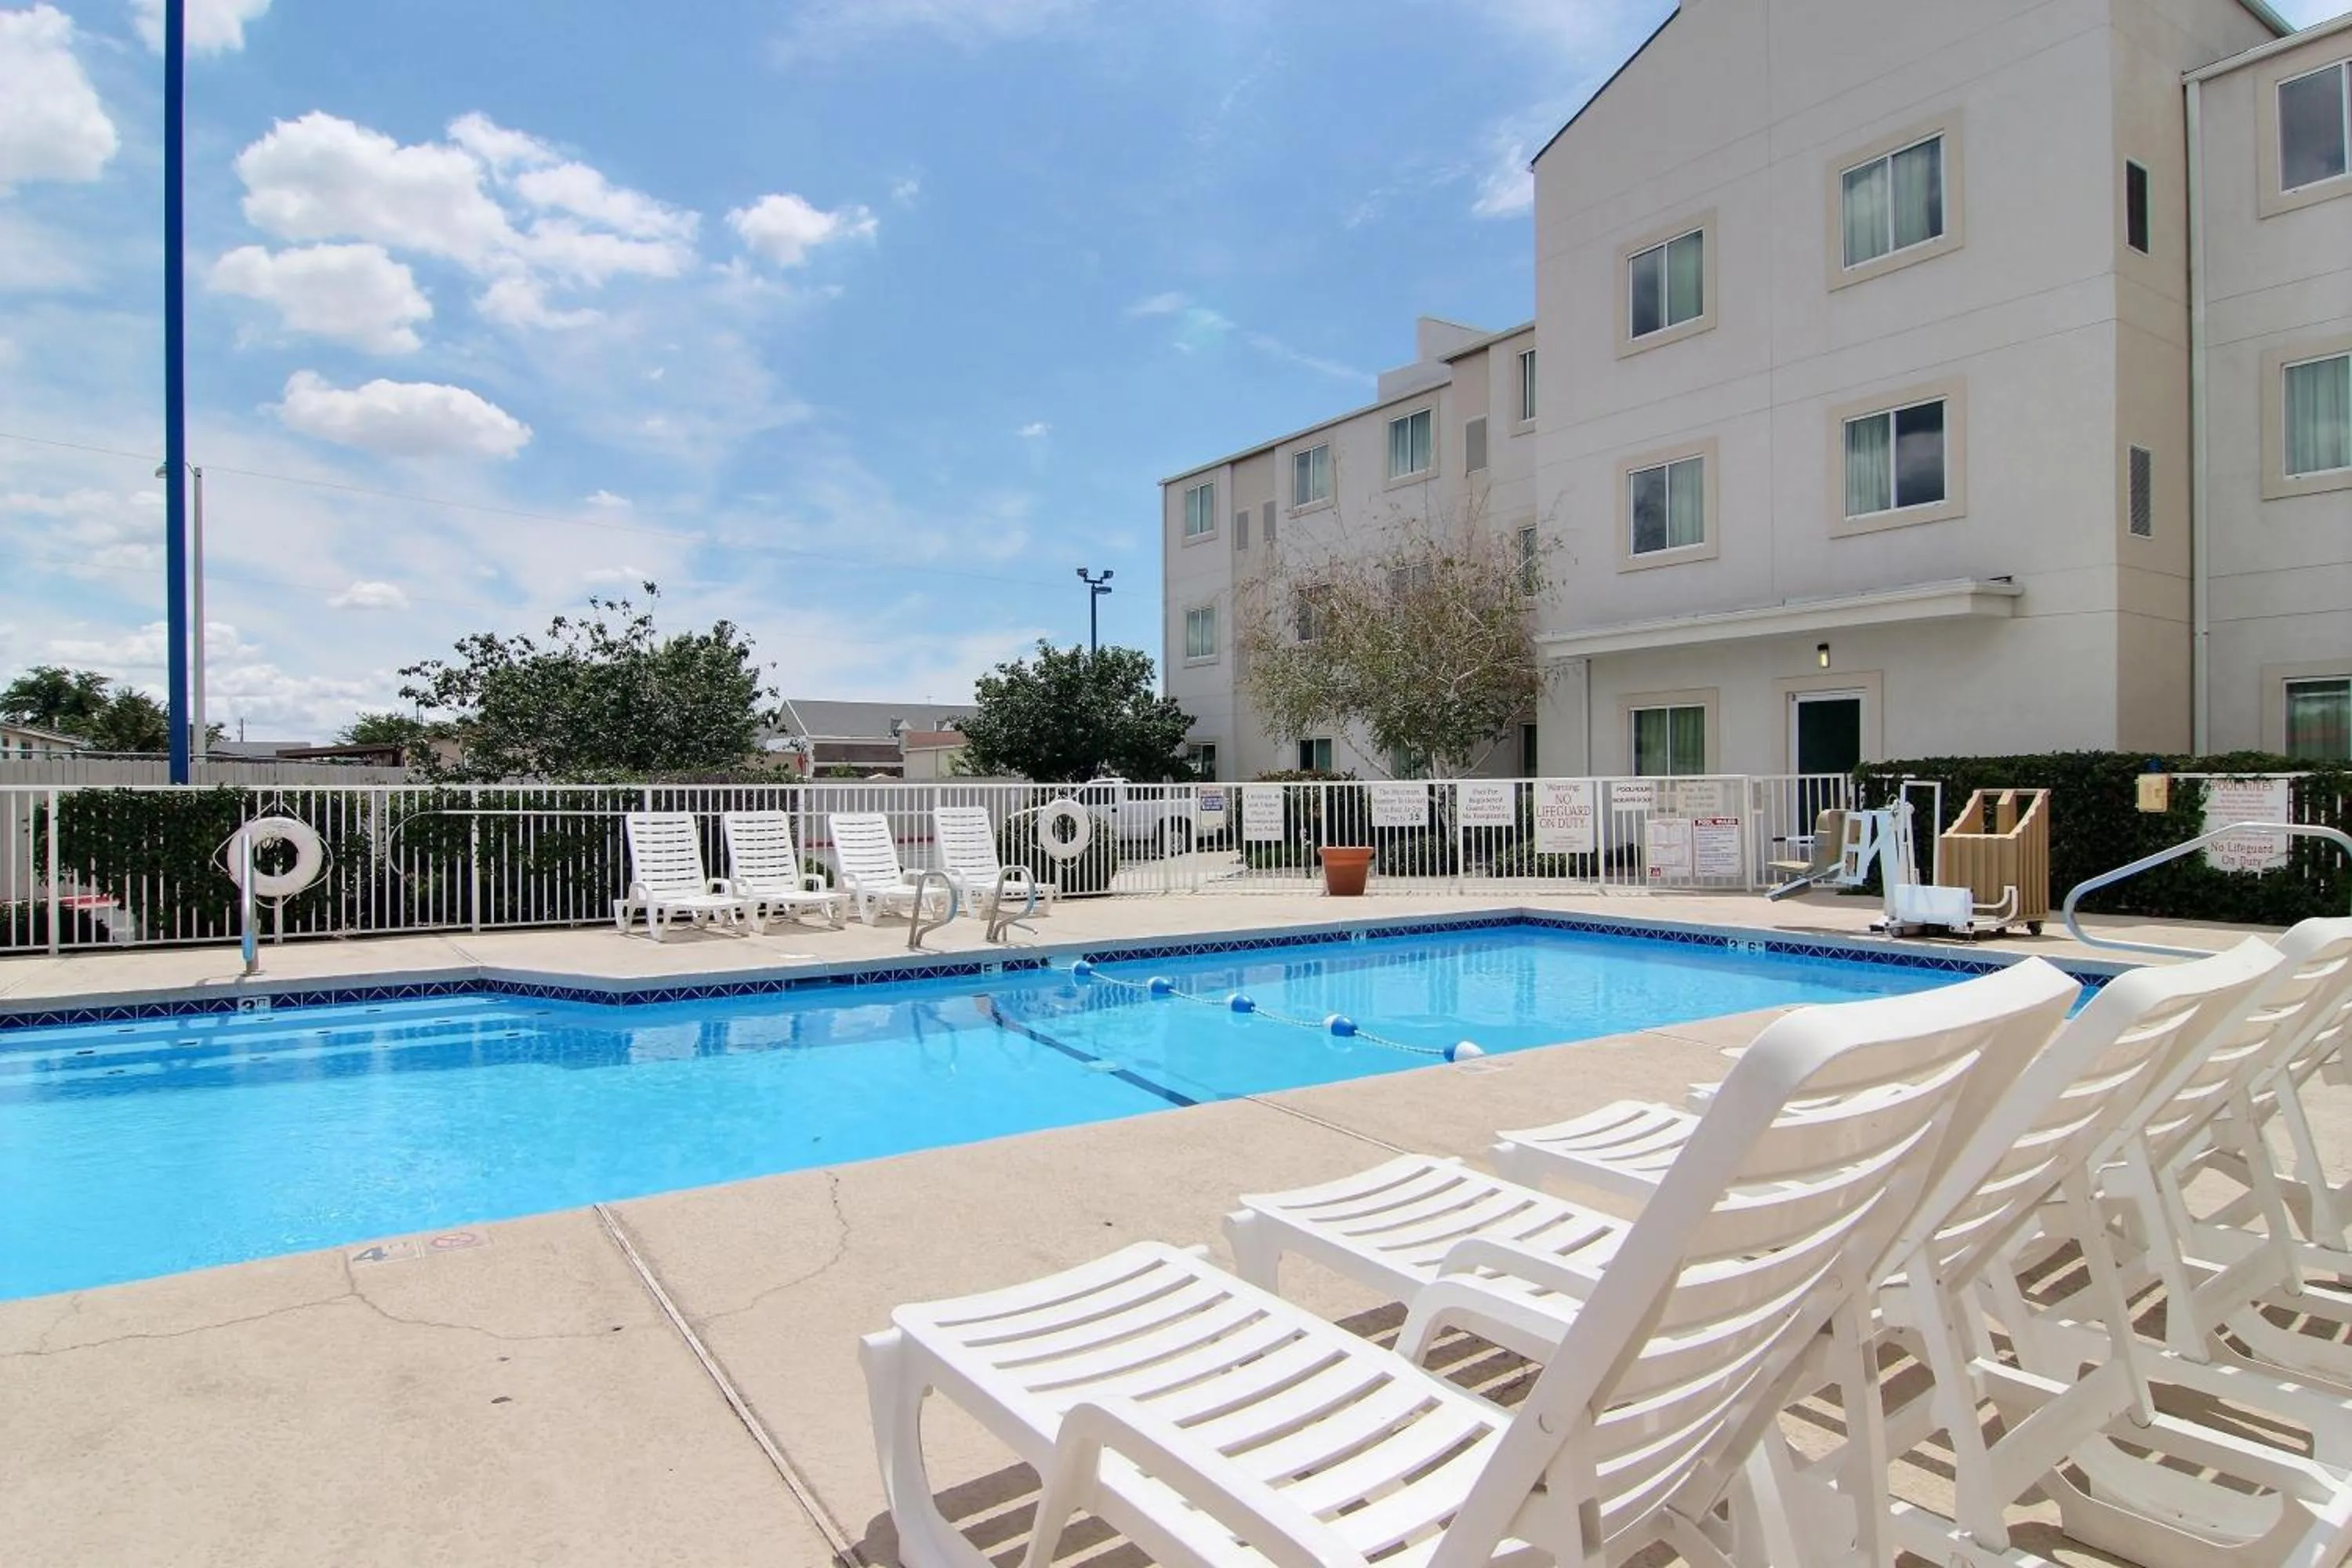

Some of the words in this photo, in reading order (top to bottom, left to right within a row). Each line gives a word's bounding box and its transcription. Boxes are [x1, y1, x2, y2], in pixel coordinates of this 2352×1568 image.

[2212, 779, 2239, 791] POOL
[1555, 793, 1572, 804] NO
[1537, 805, 1592, 817] LIFEGUARD
[1539, 818, 1555, 829] ON
[2211, 841, 2224, 852] No
[2227, 842, 2274, 854] Lifeguard
